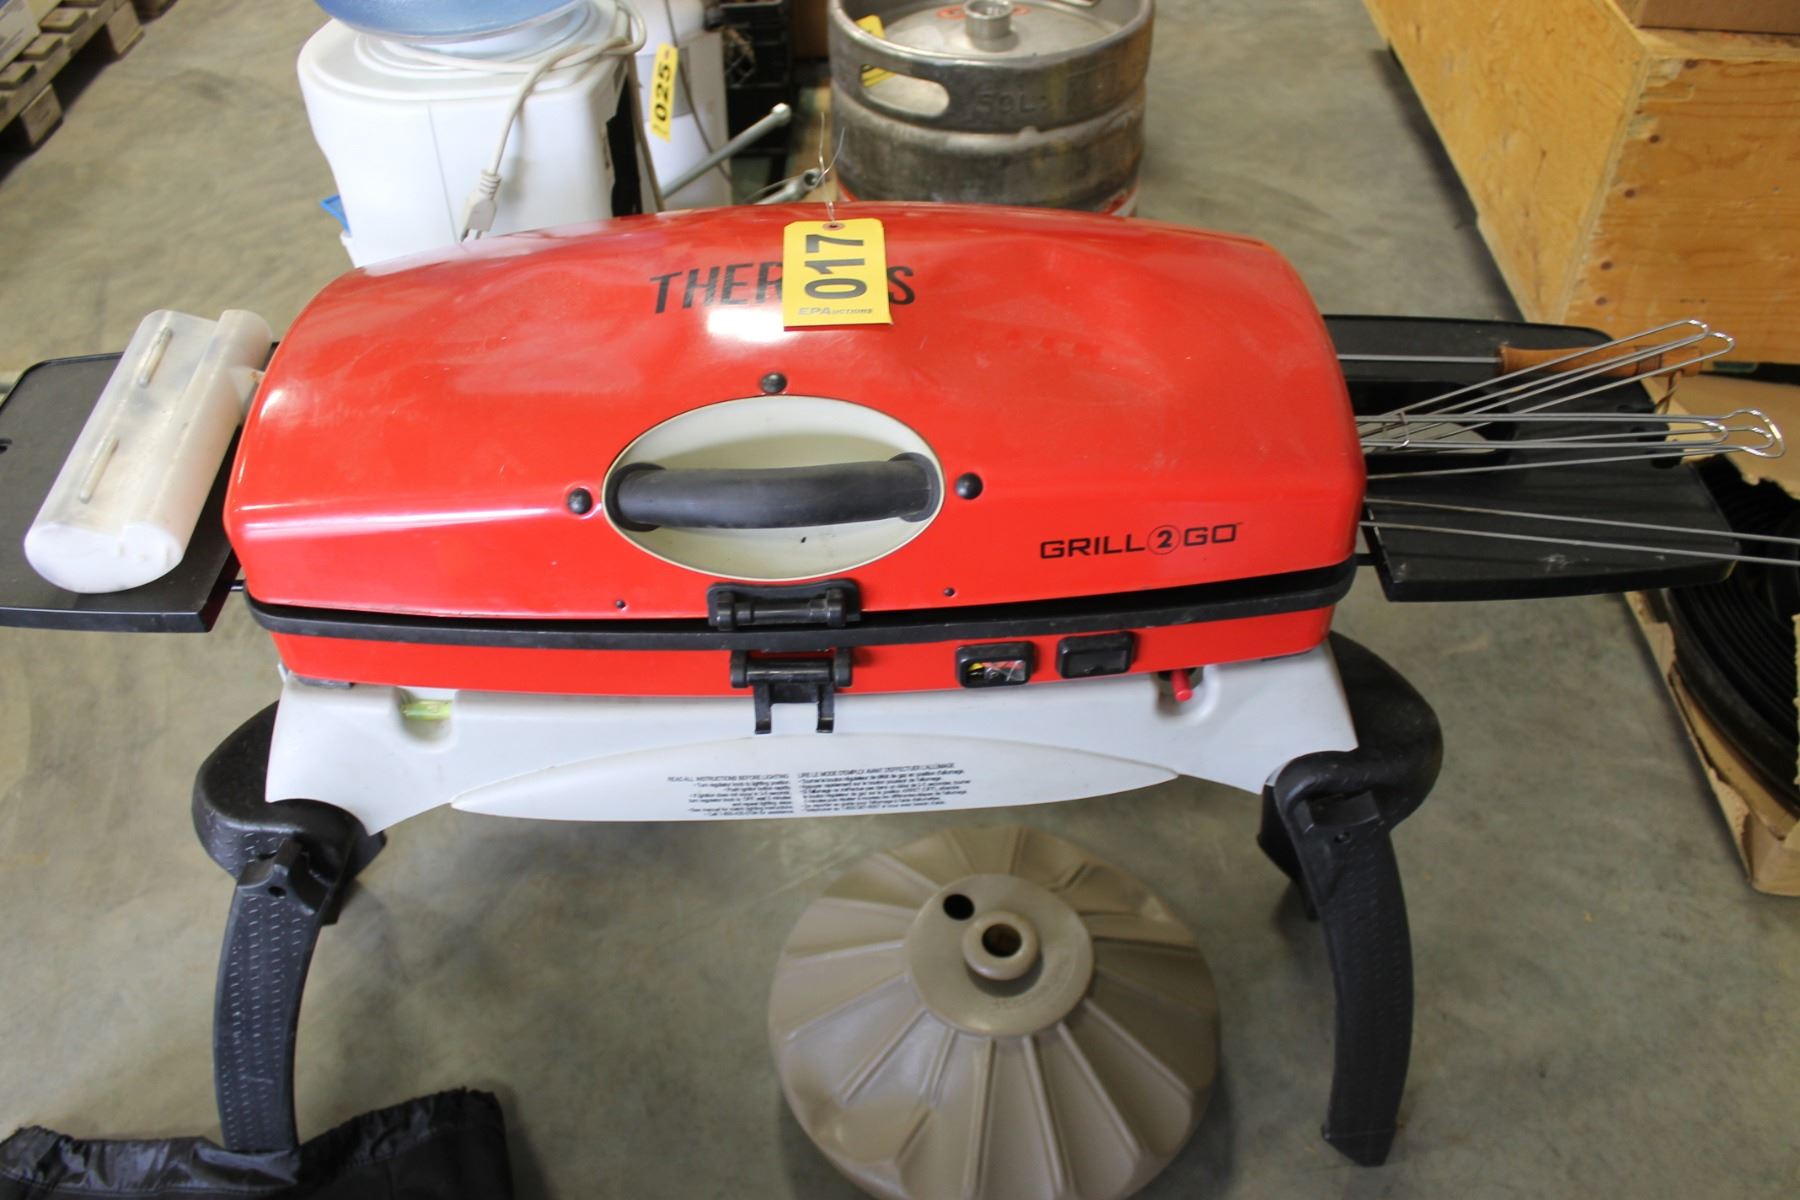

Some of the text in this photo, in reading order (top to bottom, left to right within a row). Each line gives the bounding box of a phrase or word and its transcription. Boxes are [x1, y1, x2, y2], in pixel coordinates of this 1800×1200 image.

[655, 62, 671, 122] 025
[650, 261, 916, 314] THERS
[804, 234, 868, 300] 017
